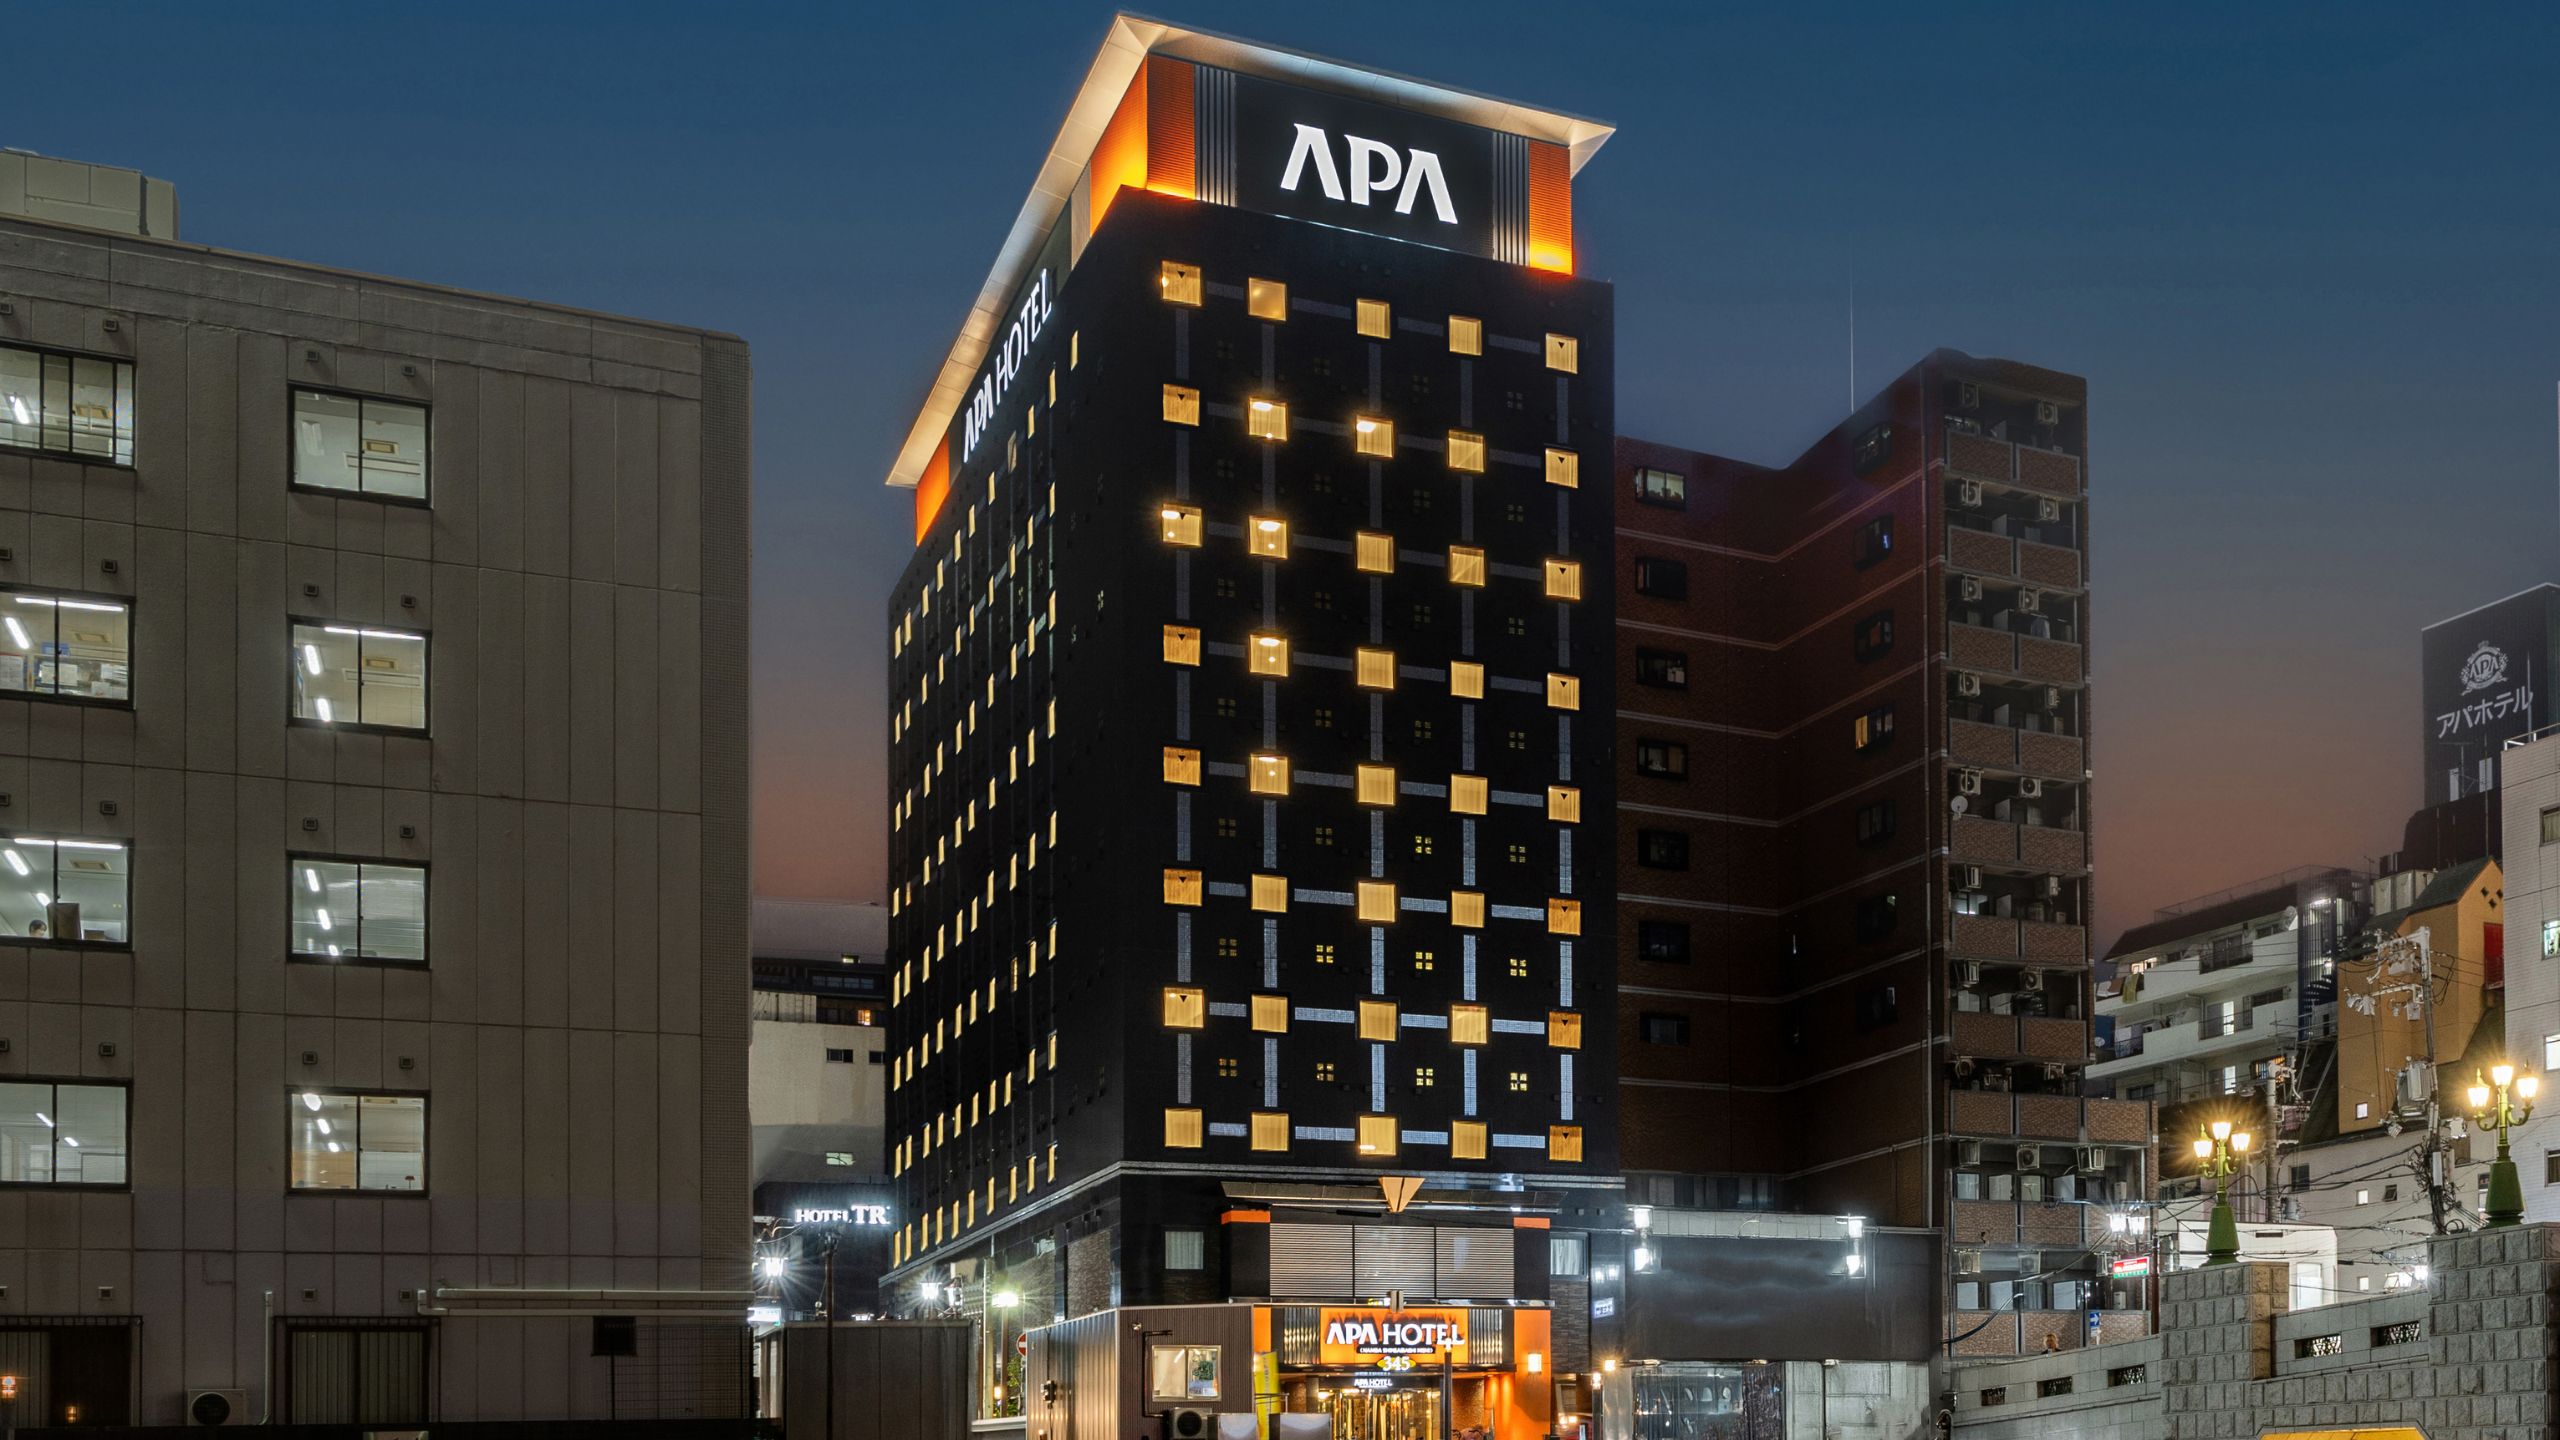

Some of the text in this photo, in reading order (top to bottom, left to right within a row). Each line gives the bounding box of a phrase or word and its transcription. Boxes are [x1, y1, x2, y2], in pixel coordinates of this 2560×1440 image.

[1280, 123, 1458, 225] APA
[963, 268, 1052, 464] APA HOTEL
[2470, 656, 2499, 679] APA
[2436, 686, 2534, 739] アパホテル
[795, 1204, 890, 1225] HOTEL TR
[1325, 1323, 1466, 1346] APA HOTEL
[1383, 1356, 1411, 1371] 345
